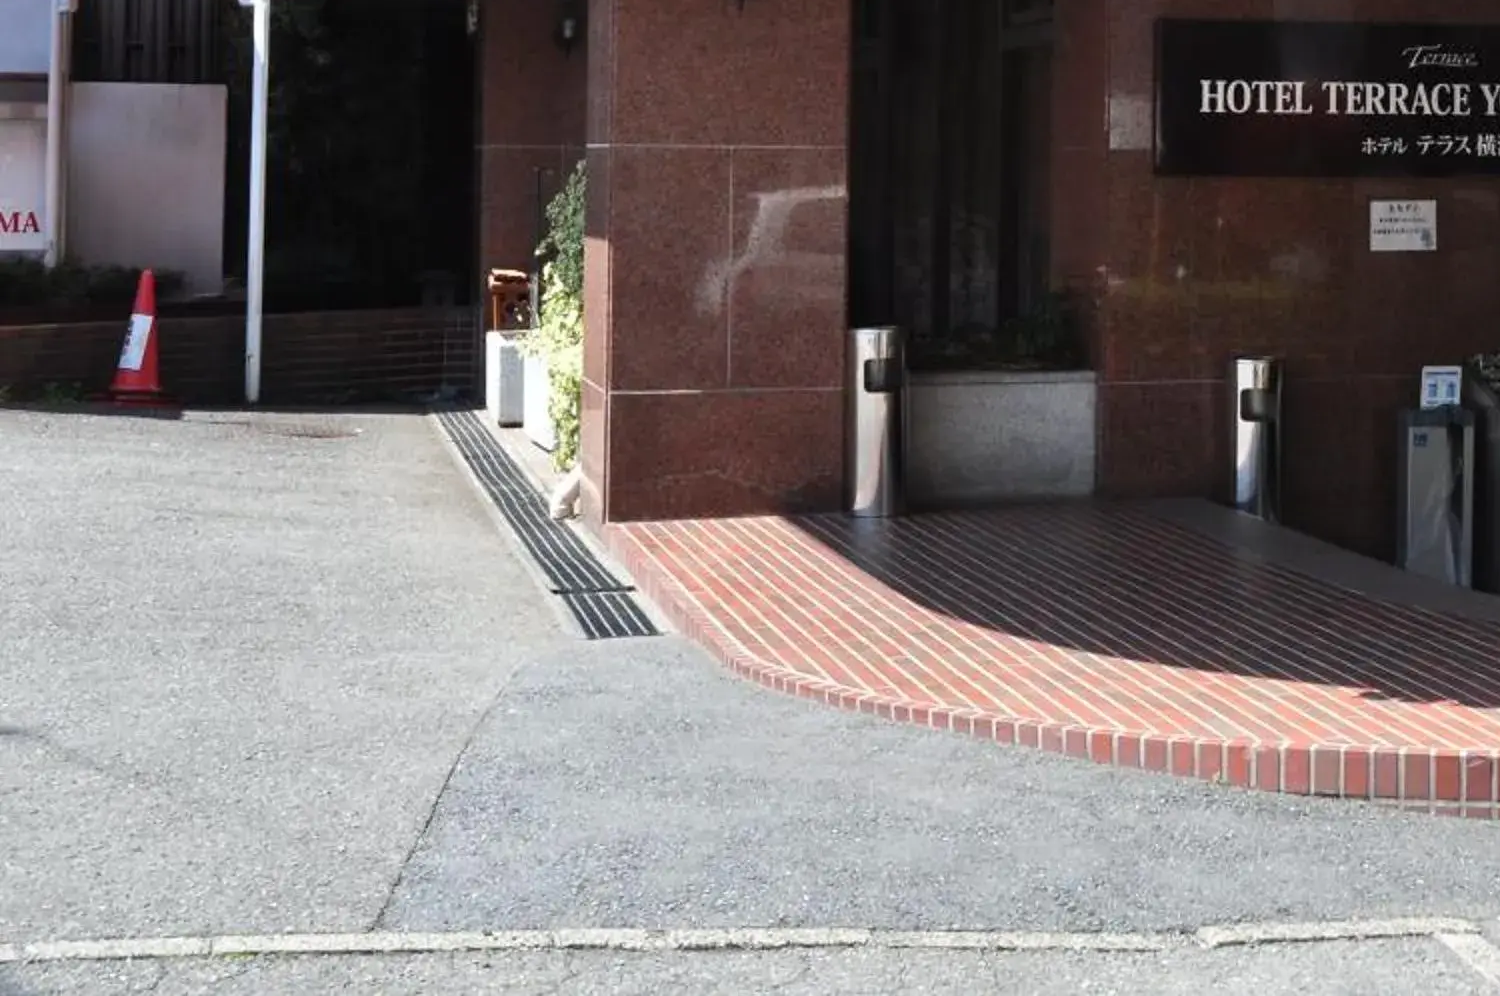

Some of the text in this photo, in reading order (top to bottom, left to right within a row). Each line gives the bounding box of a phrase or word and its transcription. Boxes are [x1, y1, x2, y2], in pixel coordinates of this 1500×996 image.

[1200, 79, 1313, 115] HOTEL
[1322, 81, 1471, 116] TERRACE
[1361, 136, 1408, 155] ホテル
